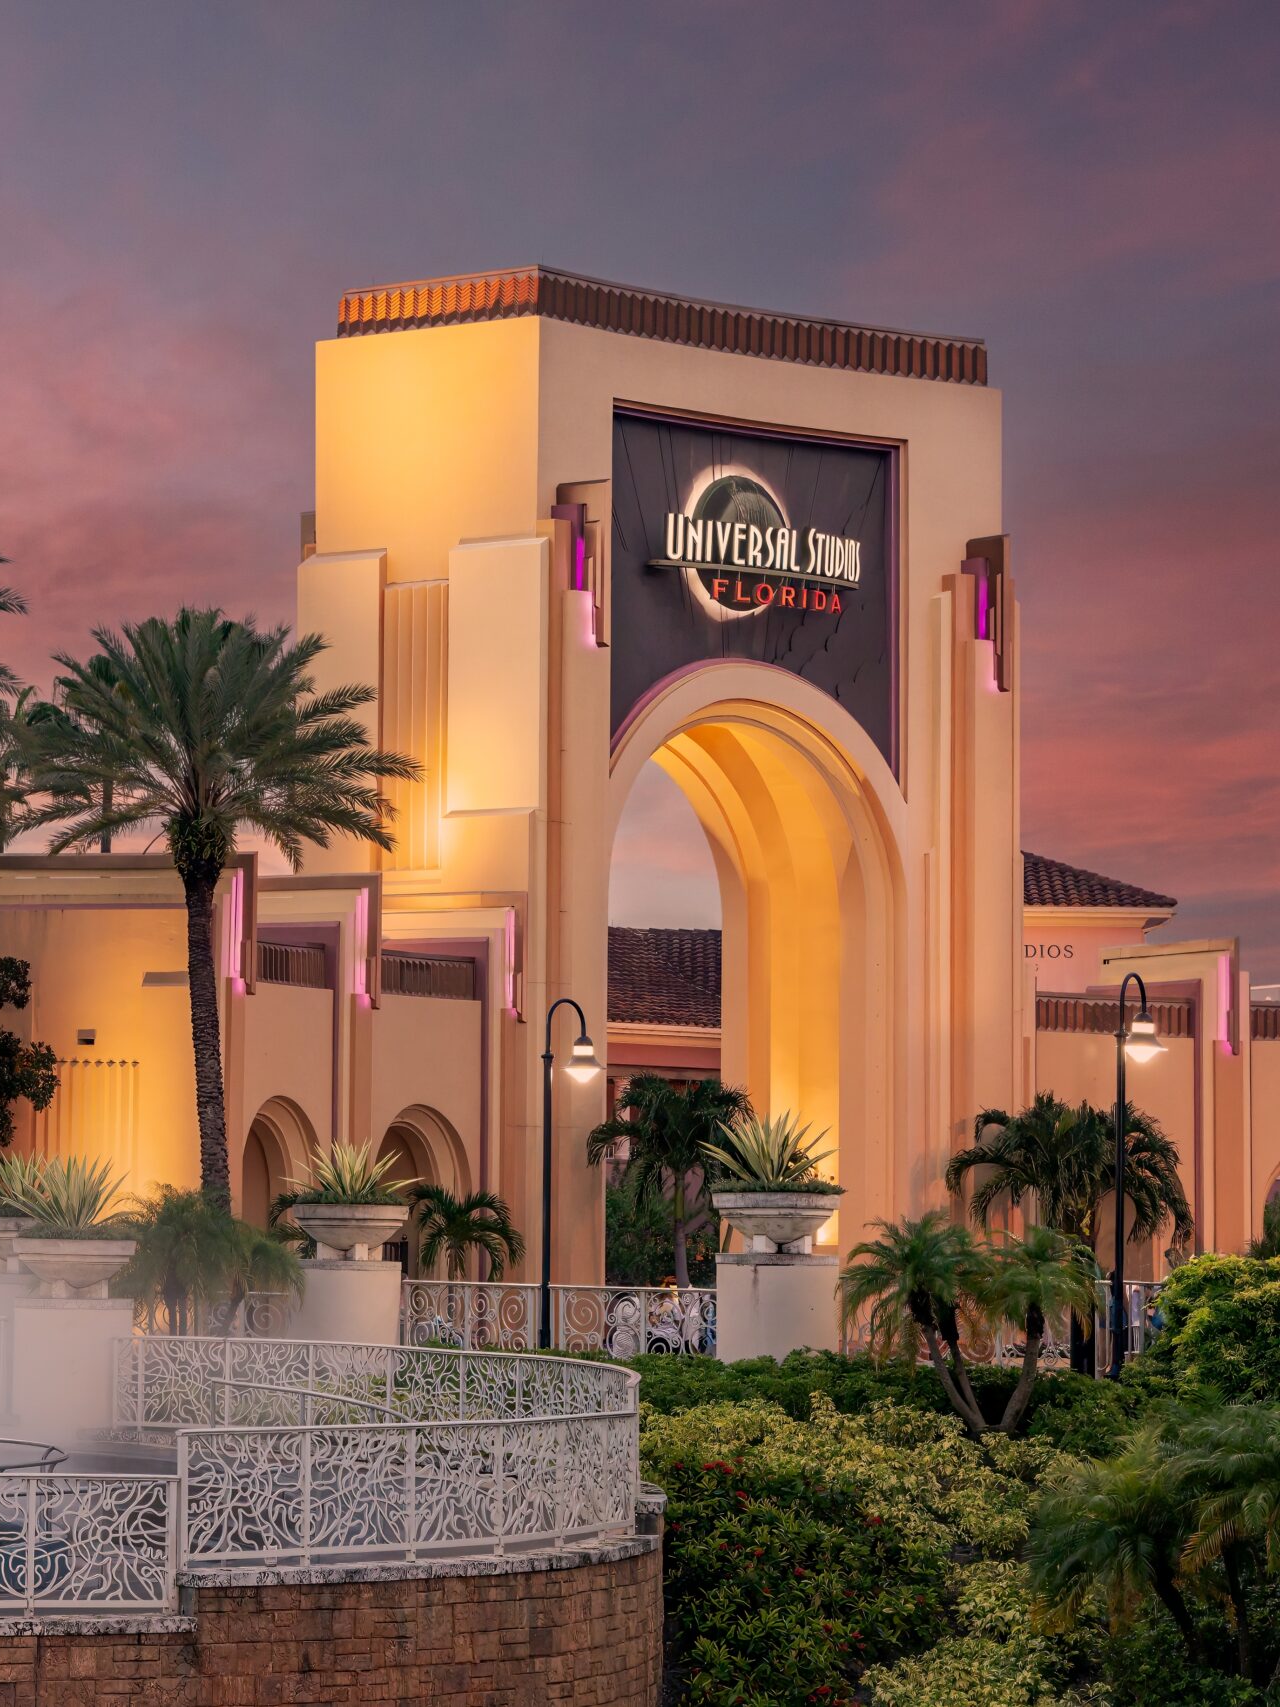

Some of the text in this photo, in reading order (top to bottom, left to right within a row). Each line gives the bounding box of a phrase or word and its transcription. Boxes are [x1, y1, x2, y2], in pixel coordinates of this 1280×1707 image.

[666, 512, 861, 582] UNIVERSAL STUDIOS
[712, 578, 842, 614] FLORIDA
[1023, 944, 1074, 958] DIOS
